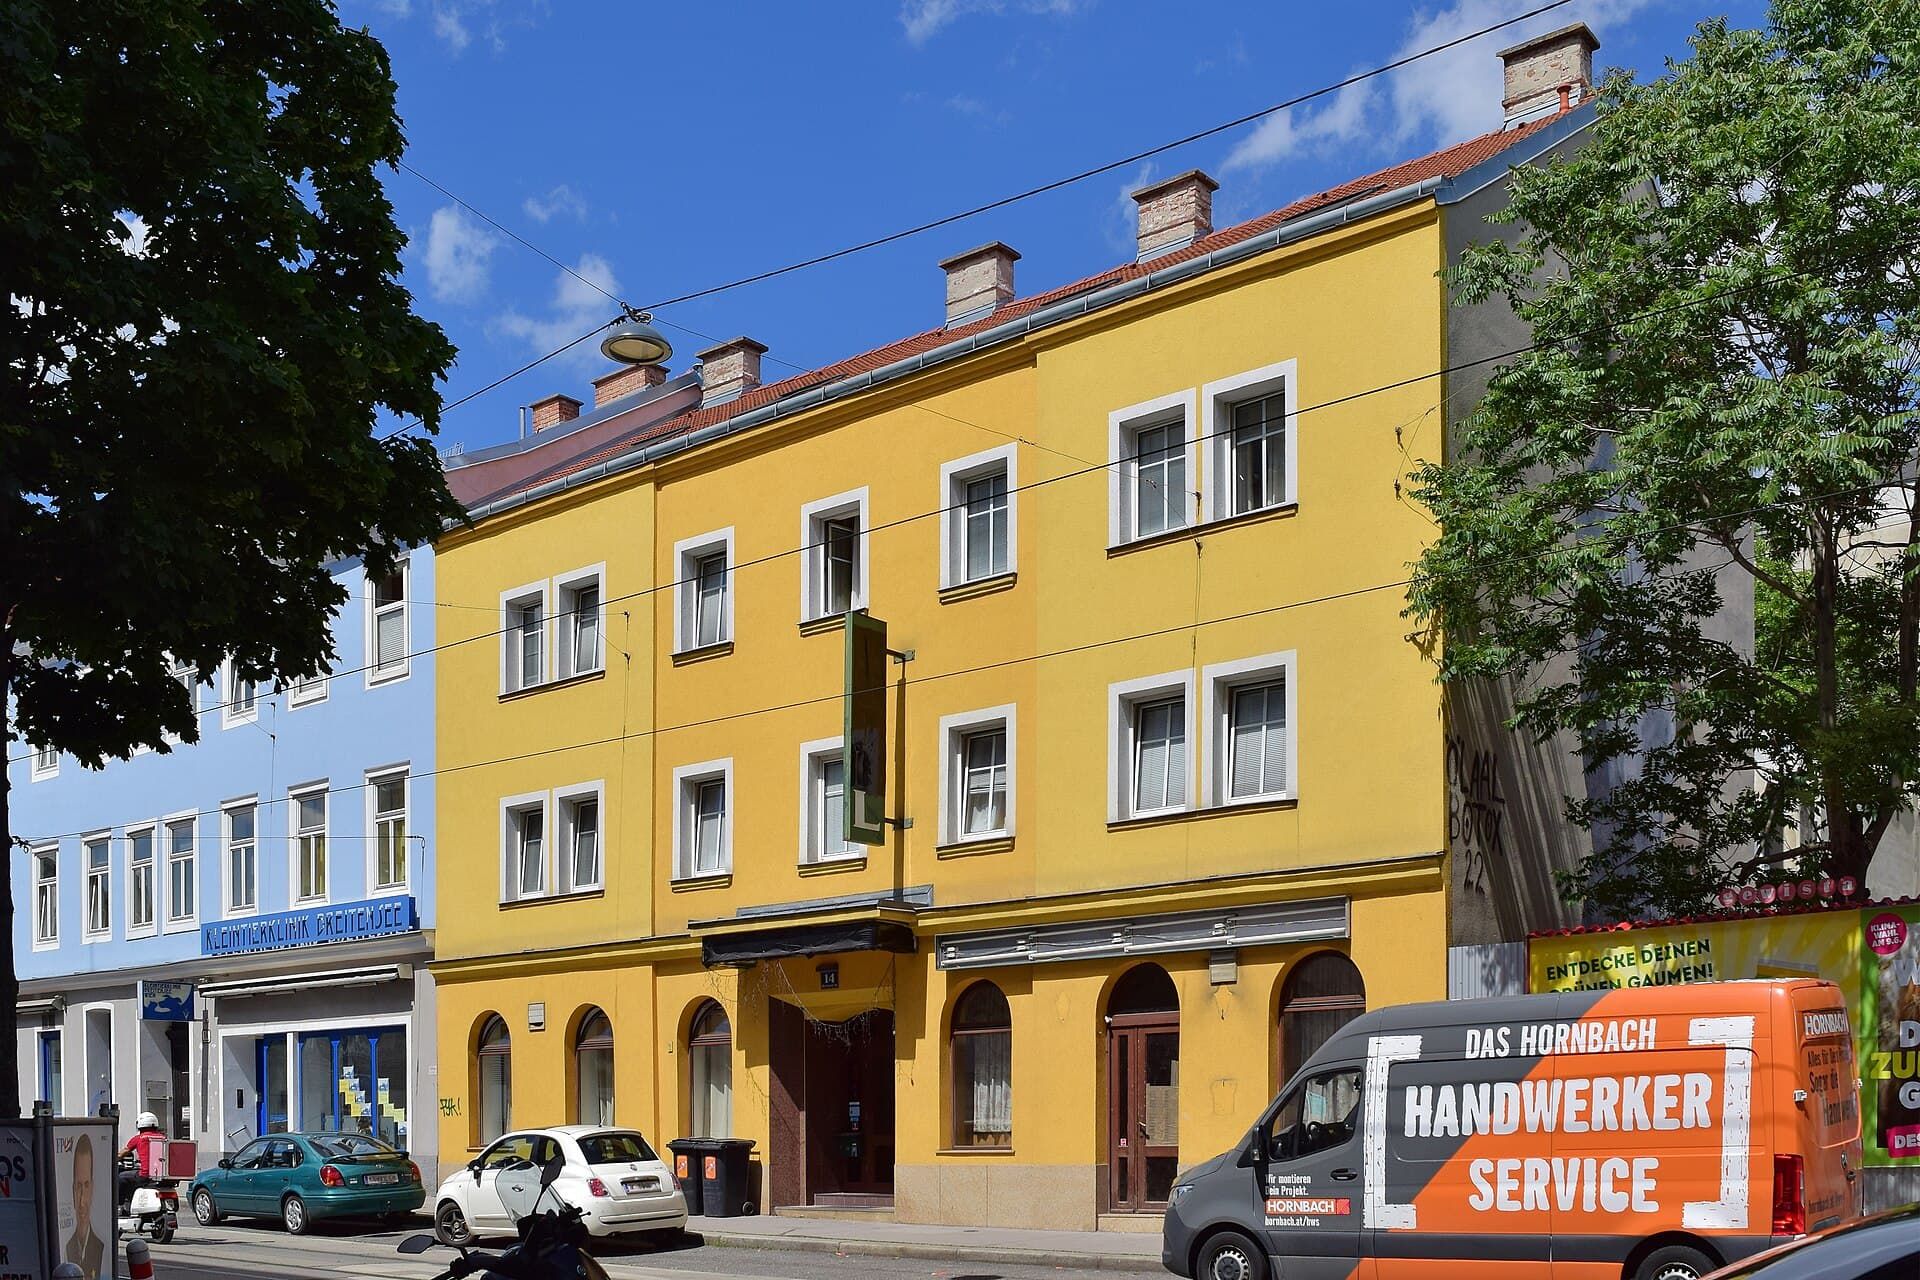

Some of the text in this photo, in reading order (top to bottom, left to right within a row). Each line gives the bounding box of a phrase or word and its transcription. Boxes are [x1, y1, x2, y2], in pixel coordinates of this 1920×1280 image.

[206, 902, 402, 951] KLEINTIERKLINIK BREITENSEE
[1870, 921, 1901, 932] KLIMA-
[1873, 929, 1899, 939] WAHL
[1872, 936, 1903, 948] AM 9.6.
[1547, 938, 1711, 980] ENTDECKE DEINEN
[824, 972, 836, 984] 14
[1549, 963, 1713, 993] ÜNEN GAUMEN!
[1804, 1013, 1849, 1036] HORNBACH
[1465, 1018, 1657, 1059] DAS HORNBACH
[1870, 1050, 1920, 1080] ZU
[1404, 1072, 1713, 1138] HANDWERKER
[1278, 1173, 1312, 1184] montieren
[1468, 1157, 1660, 1213] SERVICE
[1265, 1185, 1310, 1198] Dein Projekt.
[1267, 1200, 1335, 1213] HORNBACH
[1264, 1215, 1321, 1228] hornbach.at/hws
